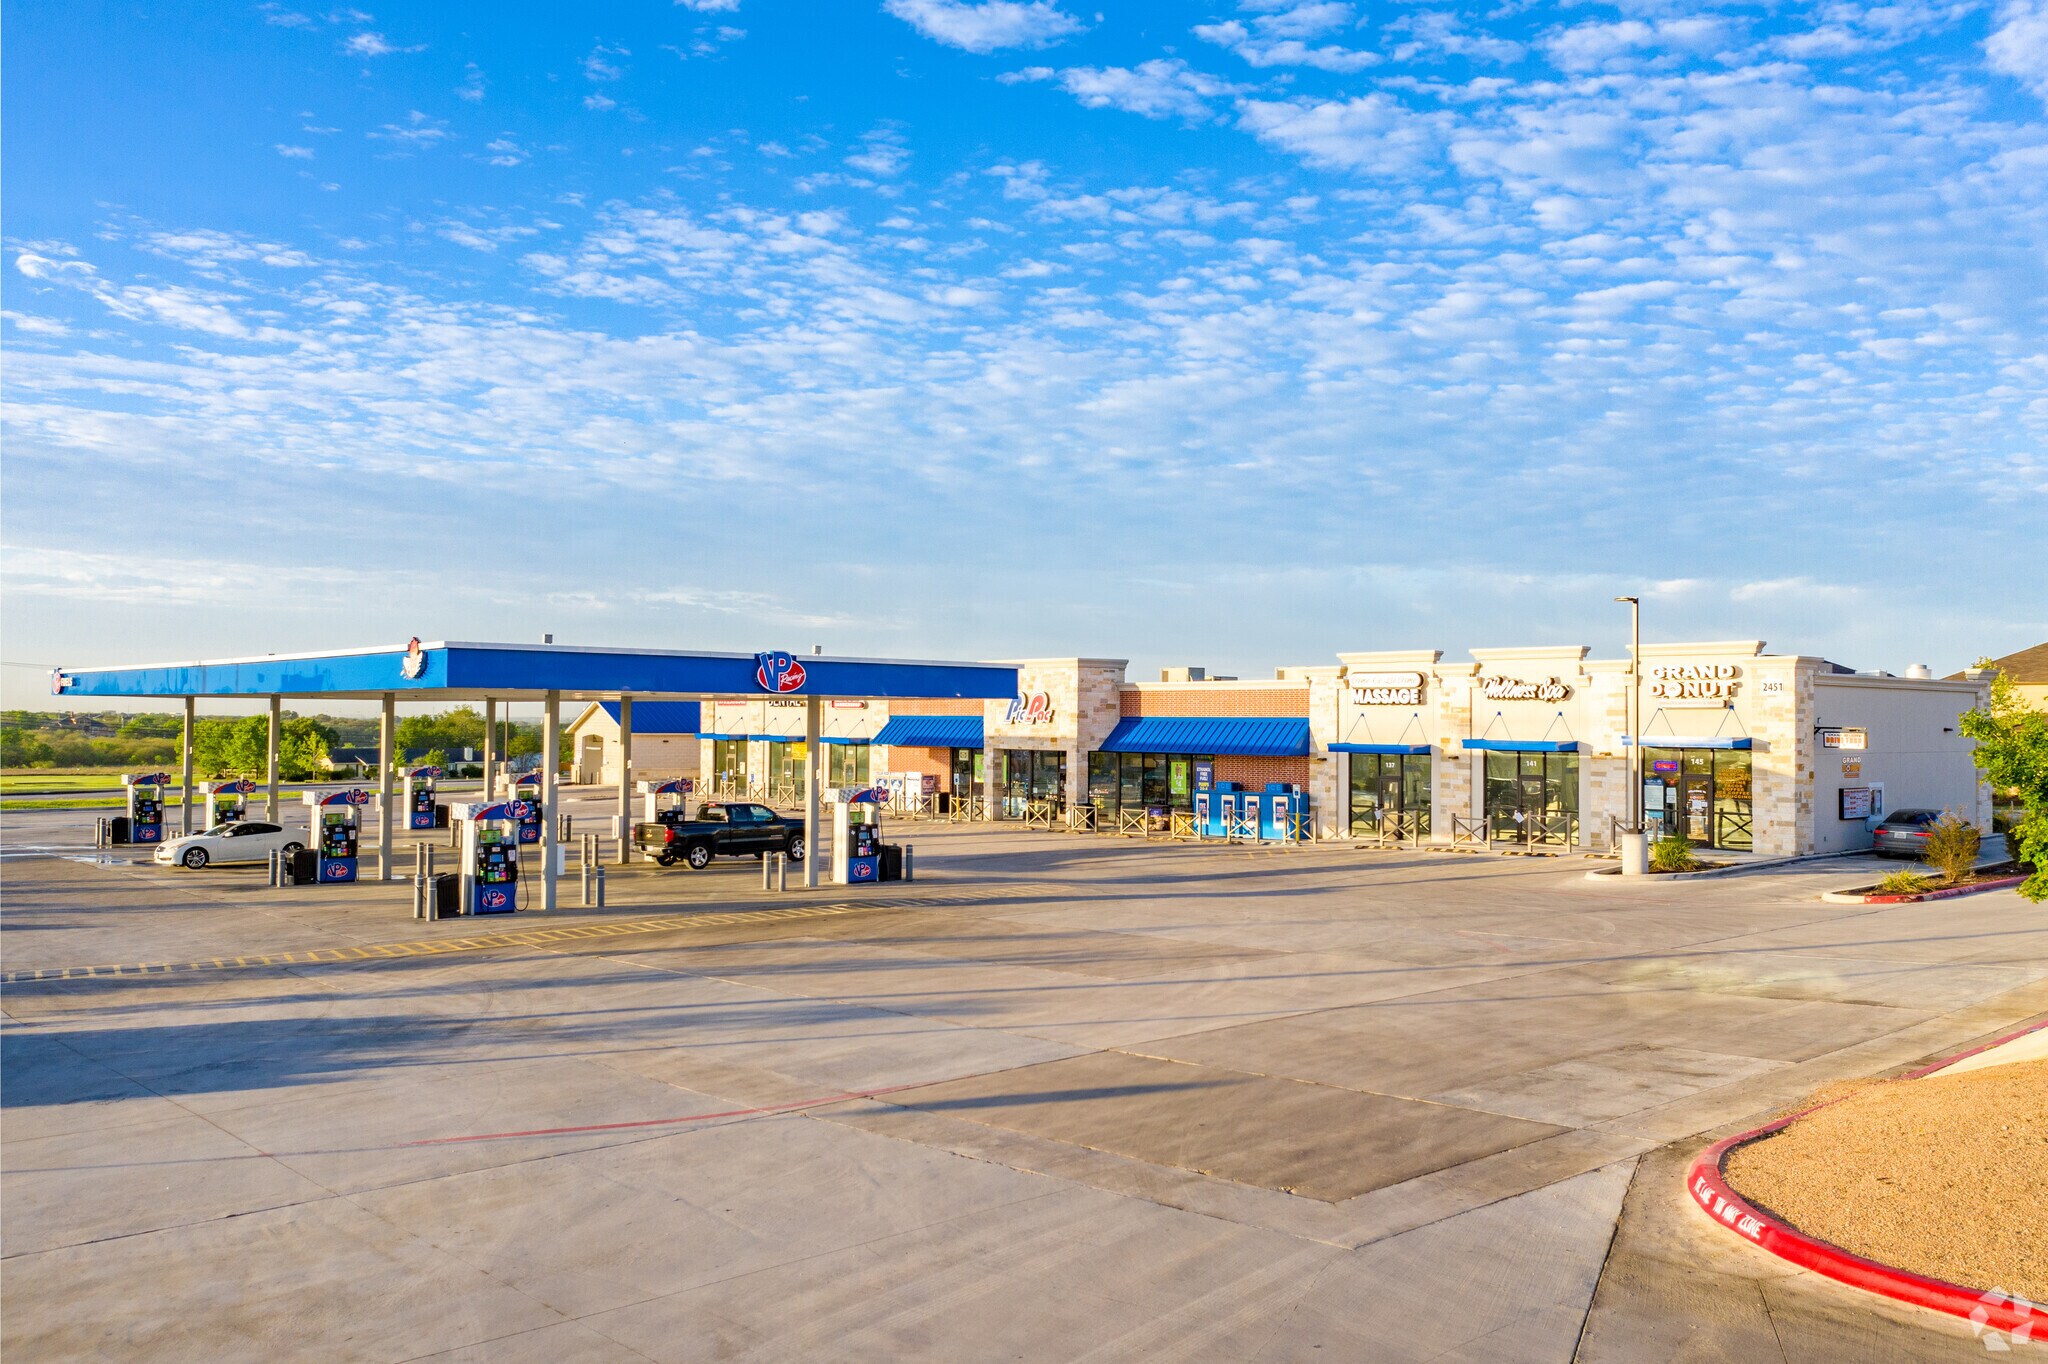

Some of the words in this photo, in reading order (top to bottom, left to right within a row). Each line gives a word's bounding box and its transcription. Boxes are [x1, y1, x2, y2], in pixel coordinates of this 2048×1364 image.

[758, 650, 792, 692] VP
[780, 672, 805, 686] Racing
[1649, 665, 1735, 680] GRAND
[1482, 677, 1538, 699] Wellness
[1538, 678, 1567, 701] Spa
[1649, 681, 1736, 697] DONUT
[1762, 682, 1784, 692] 2451
[1352, 688, 1420, 705] MASSAGE
[1003, 691, 1026, 724] Pic
[1024, 691, 1052, 724] Pac
[1712, 1196, 1728, 1215] TOW
[1722, 1204, 1744, 1224] AWAY
[1737, 1214, 1766, 1239] ZONE
